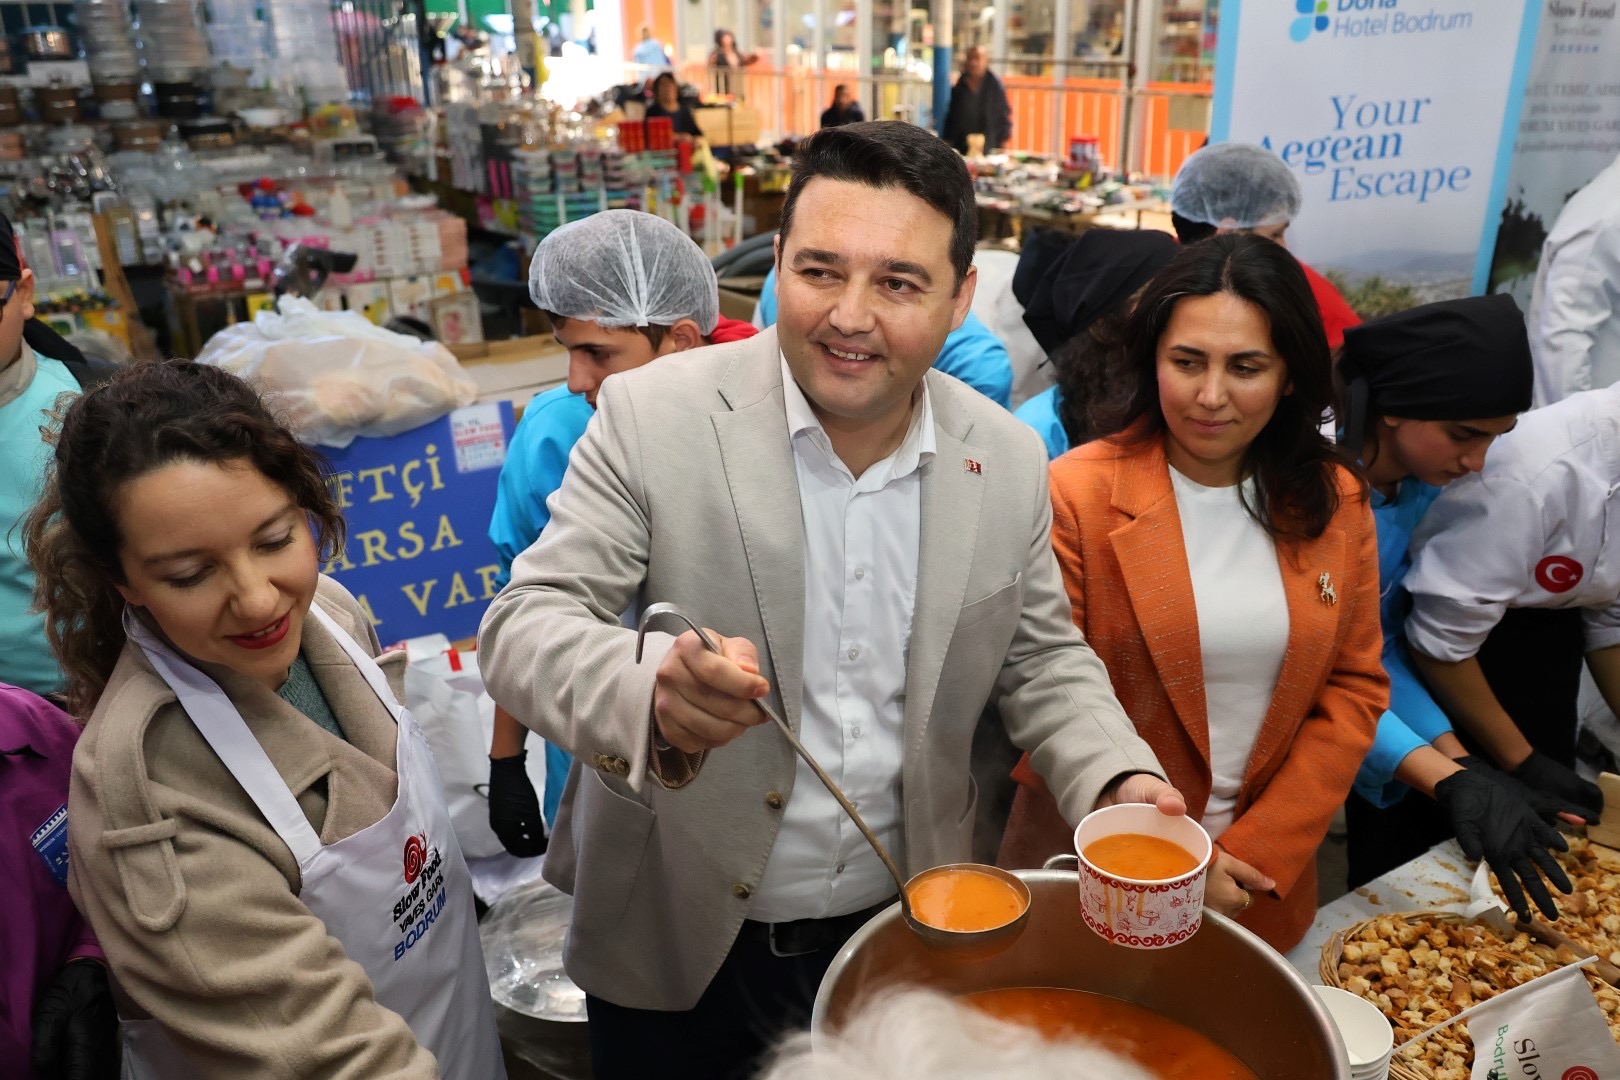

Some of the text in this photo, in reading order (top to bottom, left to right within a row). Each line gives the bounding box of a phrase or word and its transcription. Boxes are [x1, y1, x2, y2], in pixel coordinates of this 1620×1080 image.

[1333, 10, 1473, 38] Hotel Bodrum
[1329, 94, 1432, 131] Your
[1328, 164, 1472, 203] Escape
[324, 443, 446, 509] FTÇİ
[322, 514, 464, 575] ARSA
[393, 847, 442, 923] Slow Food
[394, 887, 448, 962] BODRUM
[399, 898, 426, 934] YAVEŞ
[1493, 1024, 1509, 1080] Bodru
